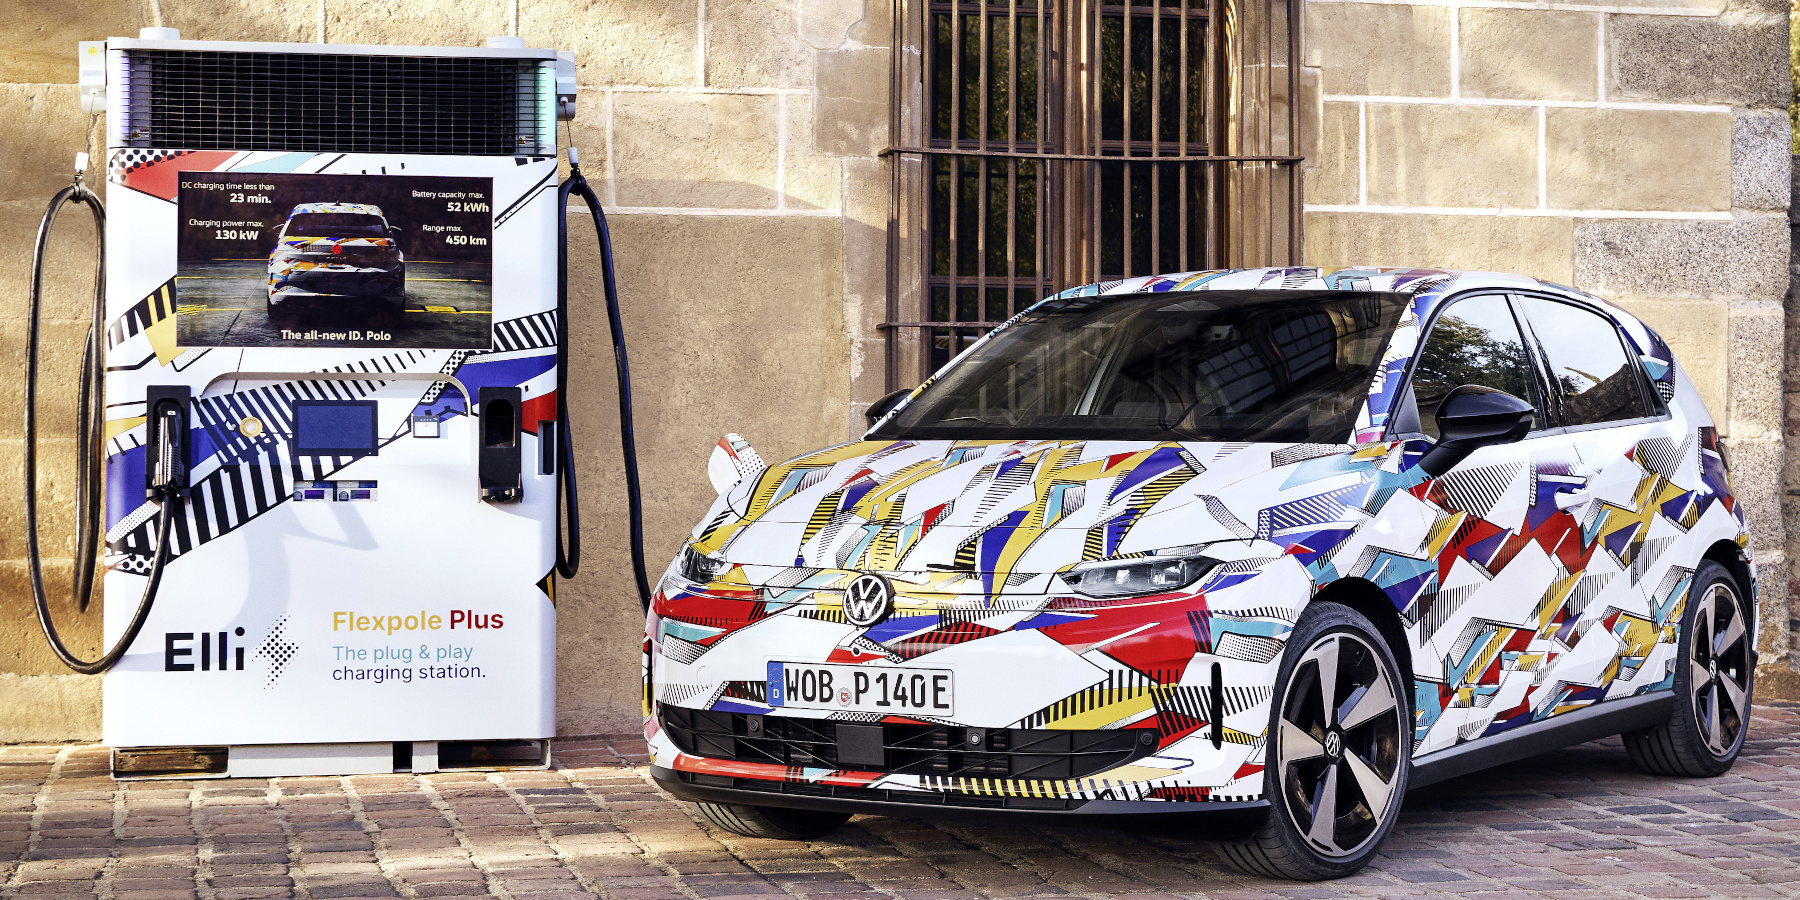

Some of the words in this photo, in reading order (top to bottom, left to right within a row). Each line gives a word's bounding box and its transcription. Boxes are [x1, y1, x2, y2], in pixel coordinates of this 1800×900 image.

[181, 181, 193, 189] DC
[193, 182, 225, 191] charging
[259, 183, 275, 191] than
[229, 193, 244, 203] 23
[247, 194, 272, 204] min.
[412, 190, 436, 199] Battery
[437, 191, 466, 200] capacity
[447, 202, 461, 212] 52
[463, 202, 490, 213] kWh
[189, 219, 221, 227] Charging
[222, 220, 245, 228] power
[422, 224, 445, 233] Range
[215, 230, 237, 240] 130
[239, 230, 260, 240] kW
[445, 235, 468, 245] 450
[469, 236, 487, 245] km
[281, 330, 302, 340] The
[303, 330, 347, 340] all-new
[348, 330, 364, 341] ID.
[366, 331, 392, 341] Polo
[333, 610, 442, 636] Flexpole
[450, 609, 504, 630] Plus
[165, 626, 246, 672] Elli
[332, 646, 368, 661] The
[373, 645, 412, 664] plug
[418, 644, 430, 660] &
[436, 644, 473, 662] play
[332, 664, 412, 684] charging
[418, 663, 486, 680] station.
[773, 688, 780, 699] D
[784, 668, 834, 703] WOB
